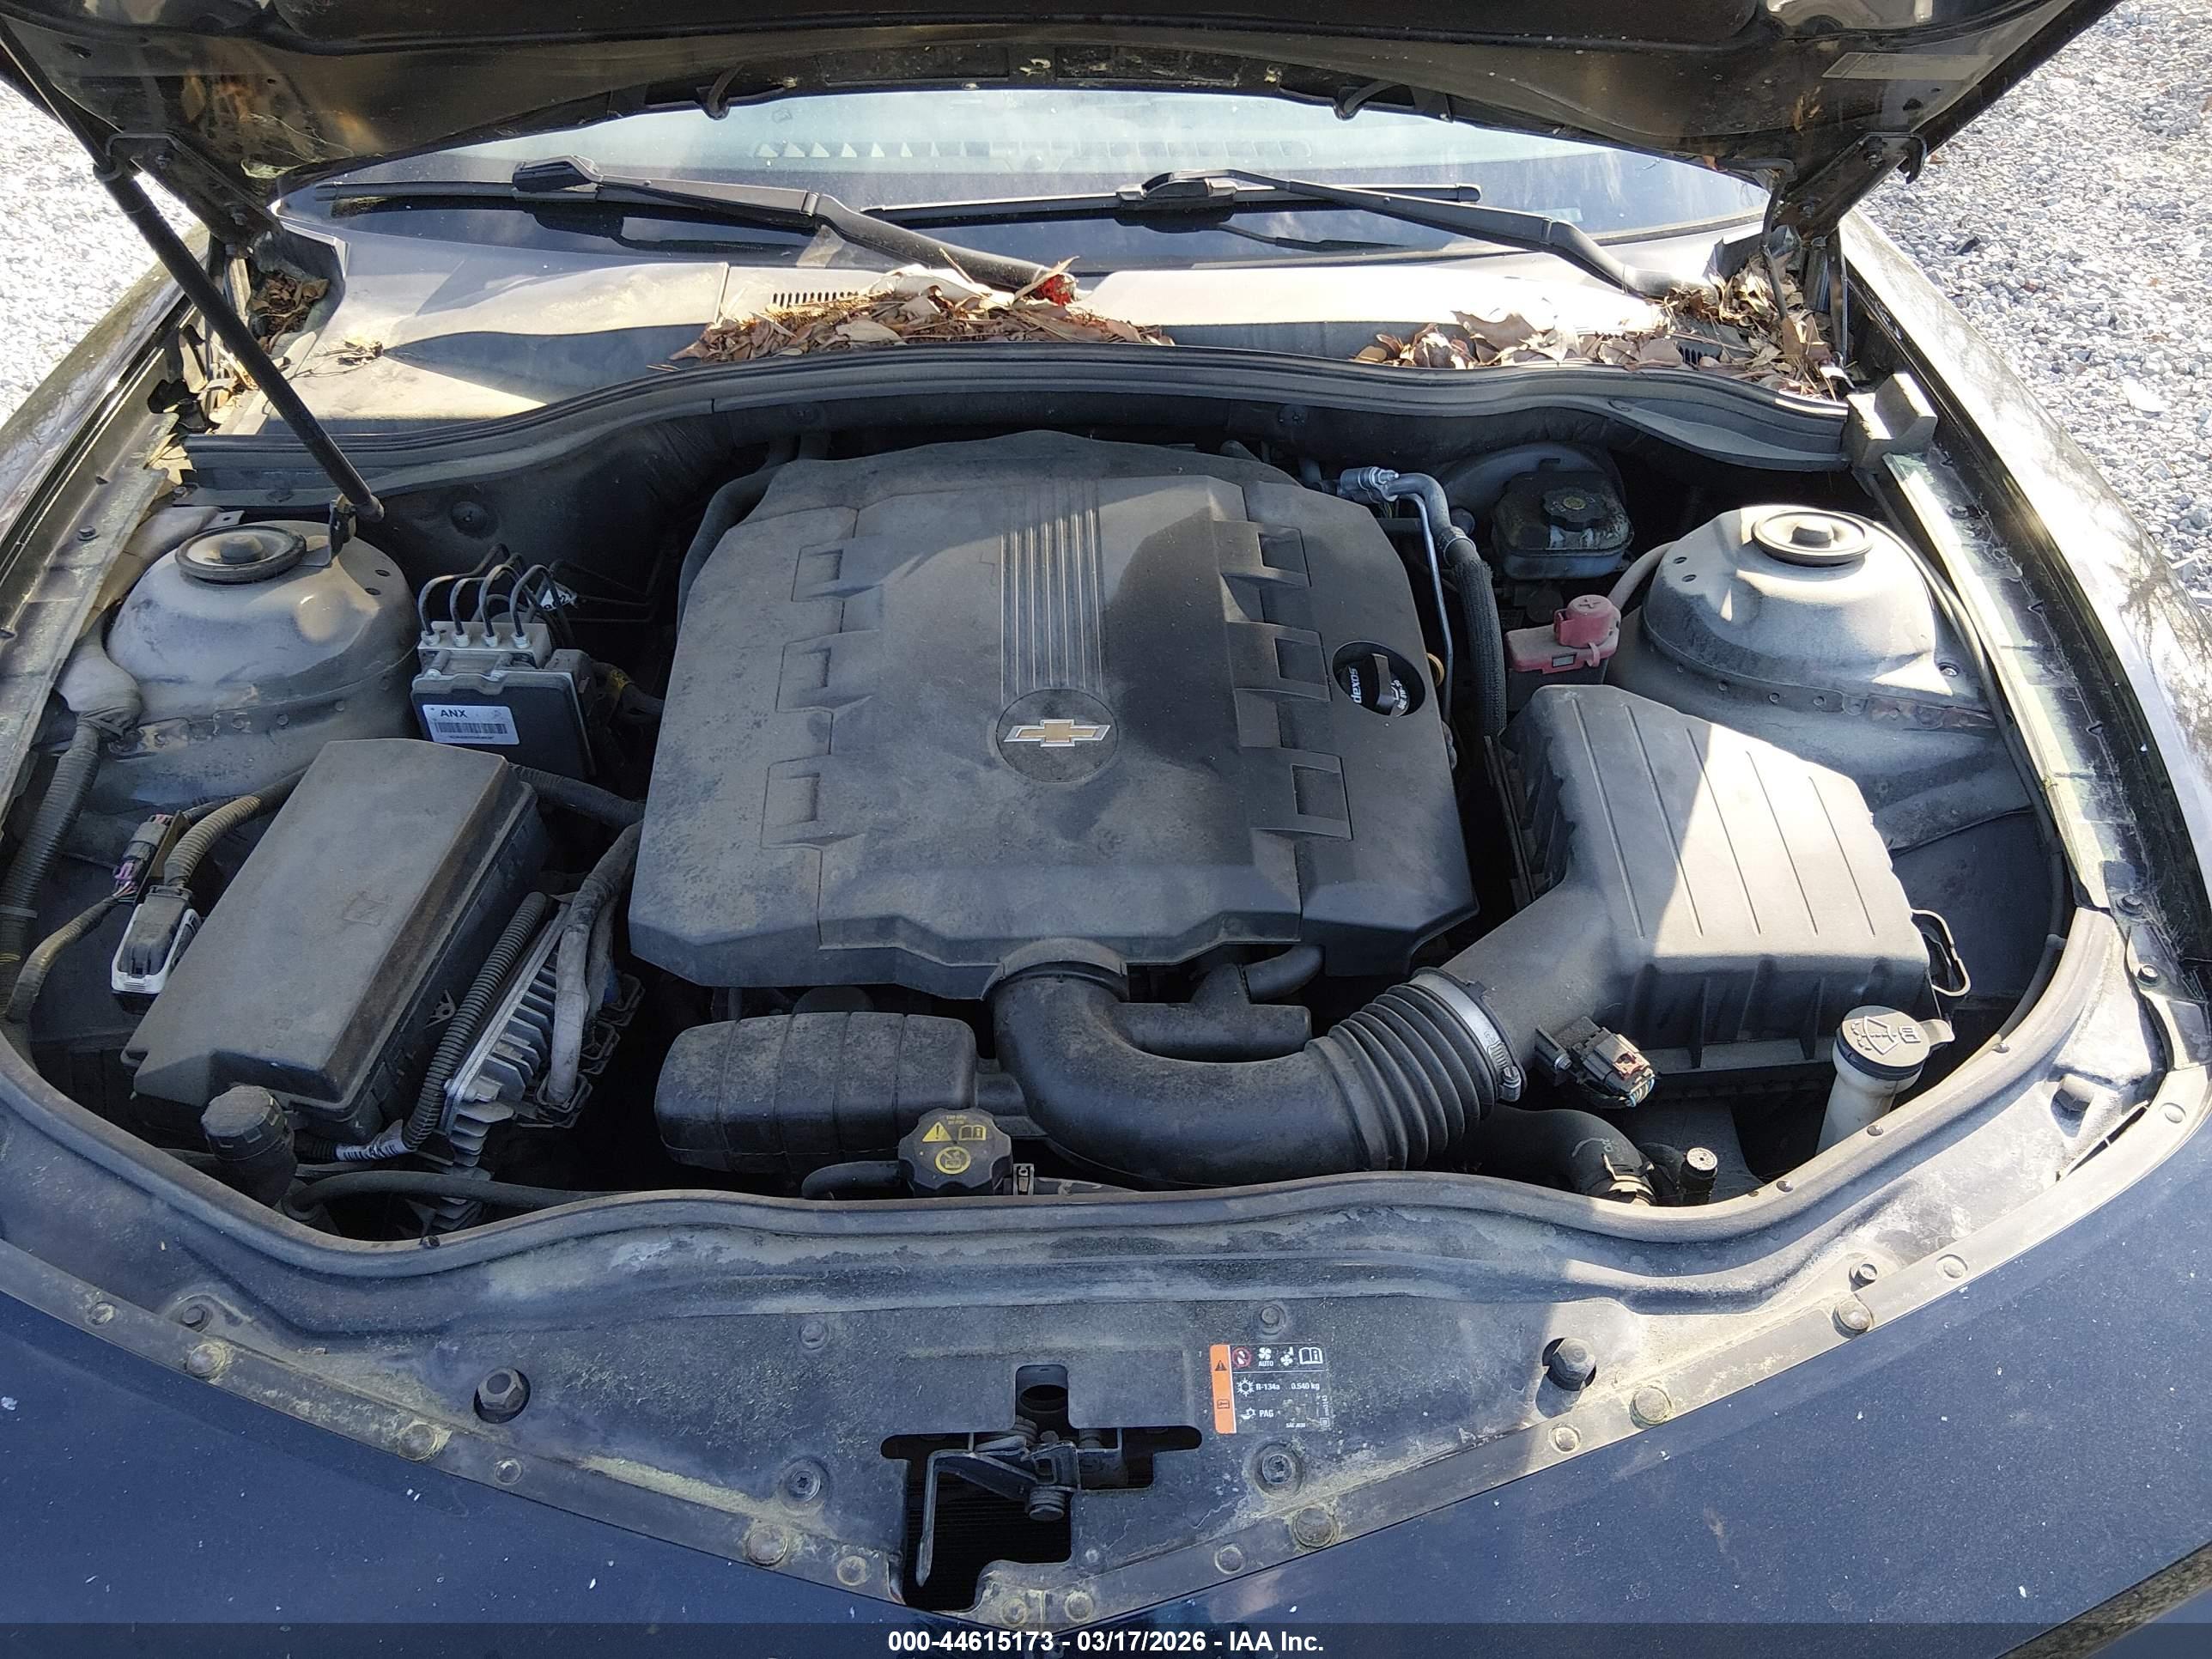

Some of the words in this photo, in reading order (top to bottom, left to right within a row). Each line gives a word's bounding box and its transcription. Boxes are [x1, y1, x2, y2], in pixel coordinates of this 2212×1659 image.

[1348, 665, 1362, 703] dexos
[440, 709, 468, 719] ANX
[1255, 1382, 1280, 1391] R-134a
[1291, 1382, 1310, 1390] 0.540
[1310, 1382, 1321, 1391] kg
[1259, 1409, 1274, 1418] PAG
